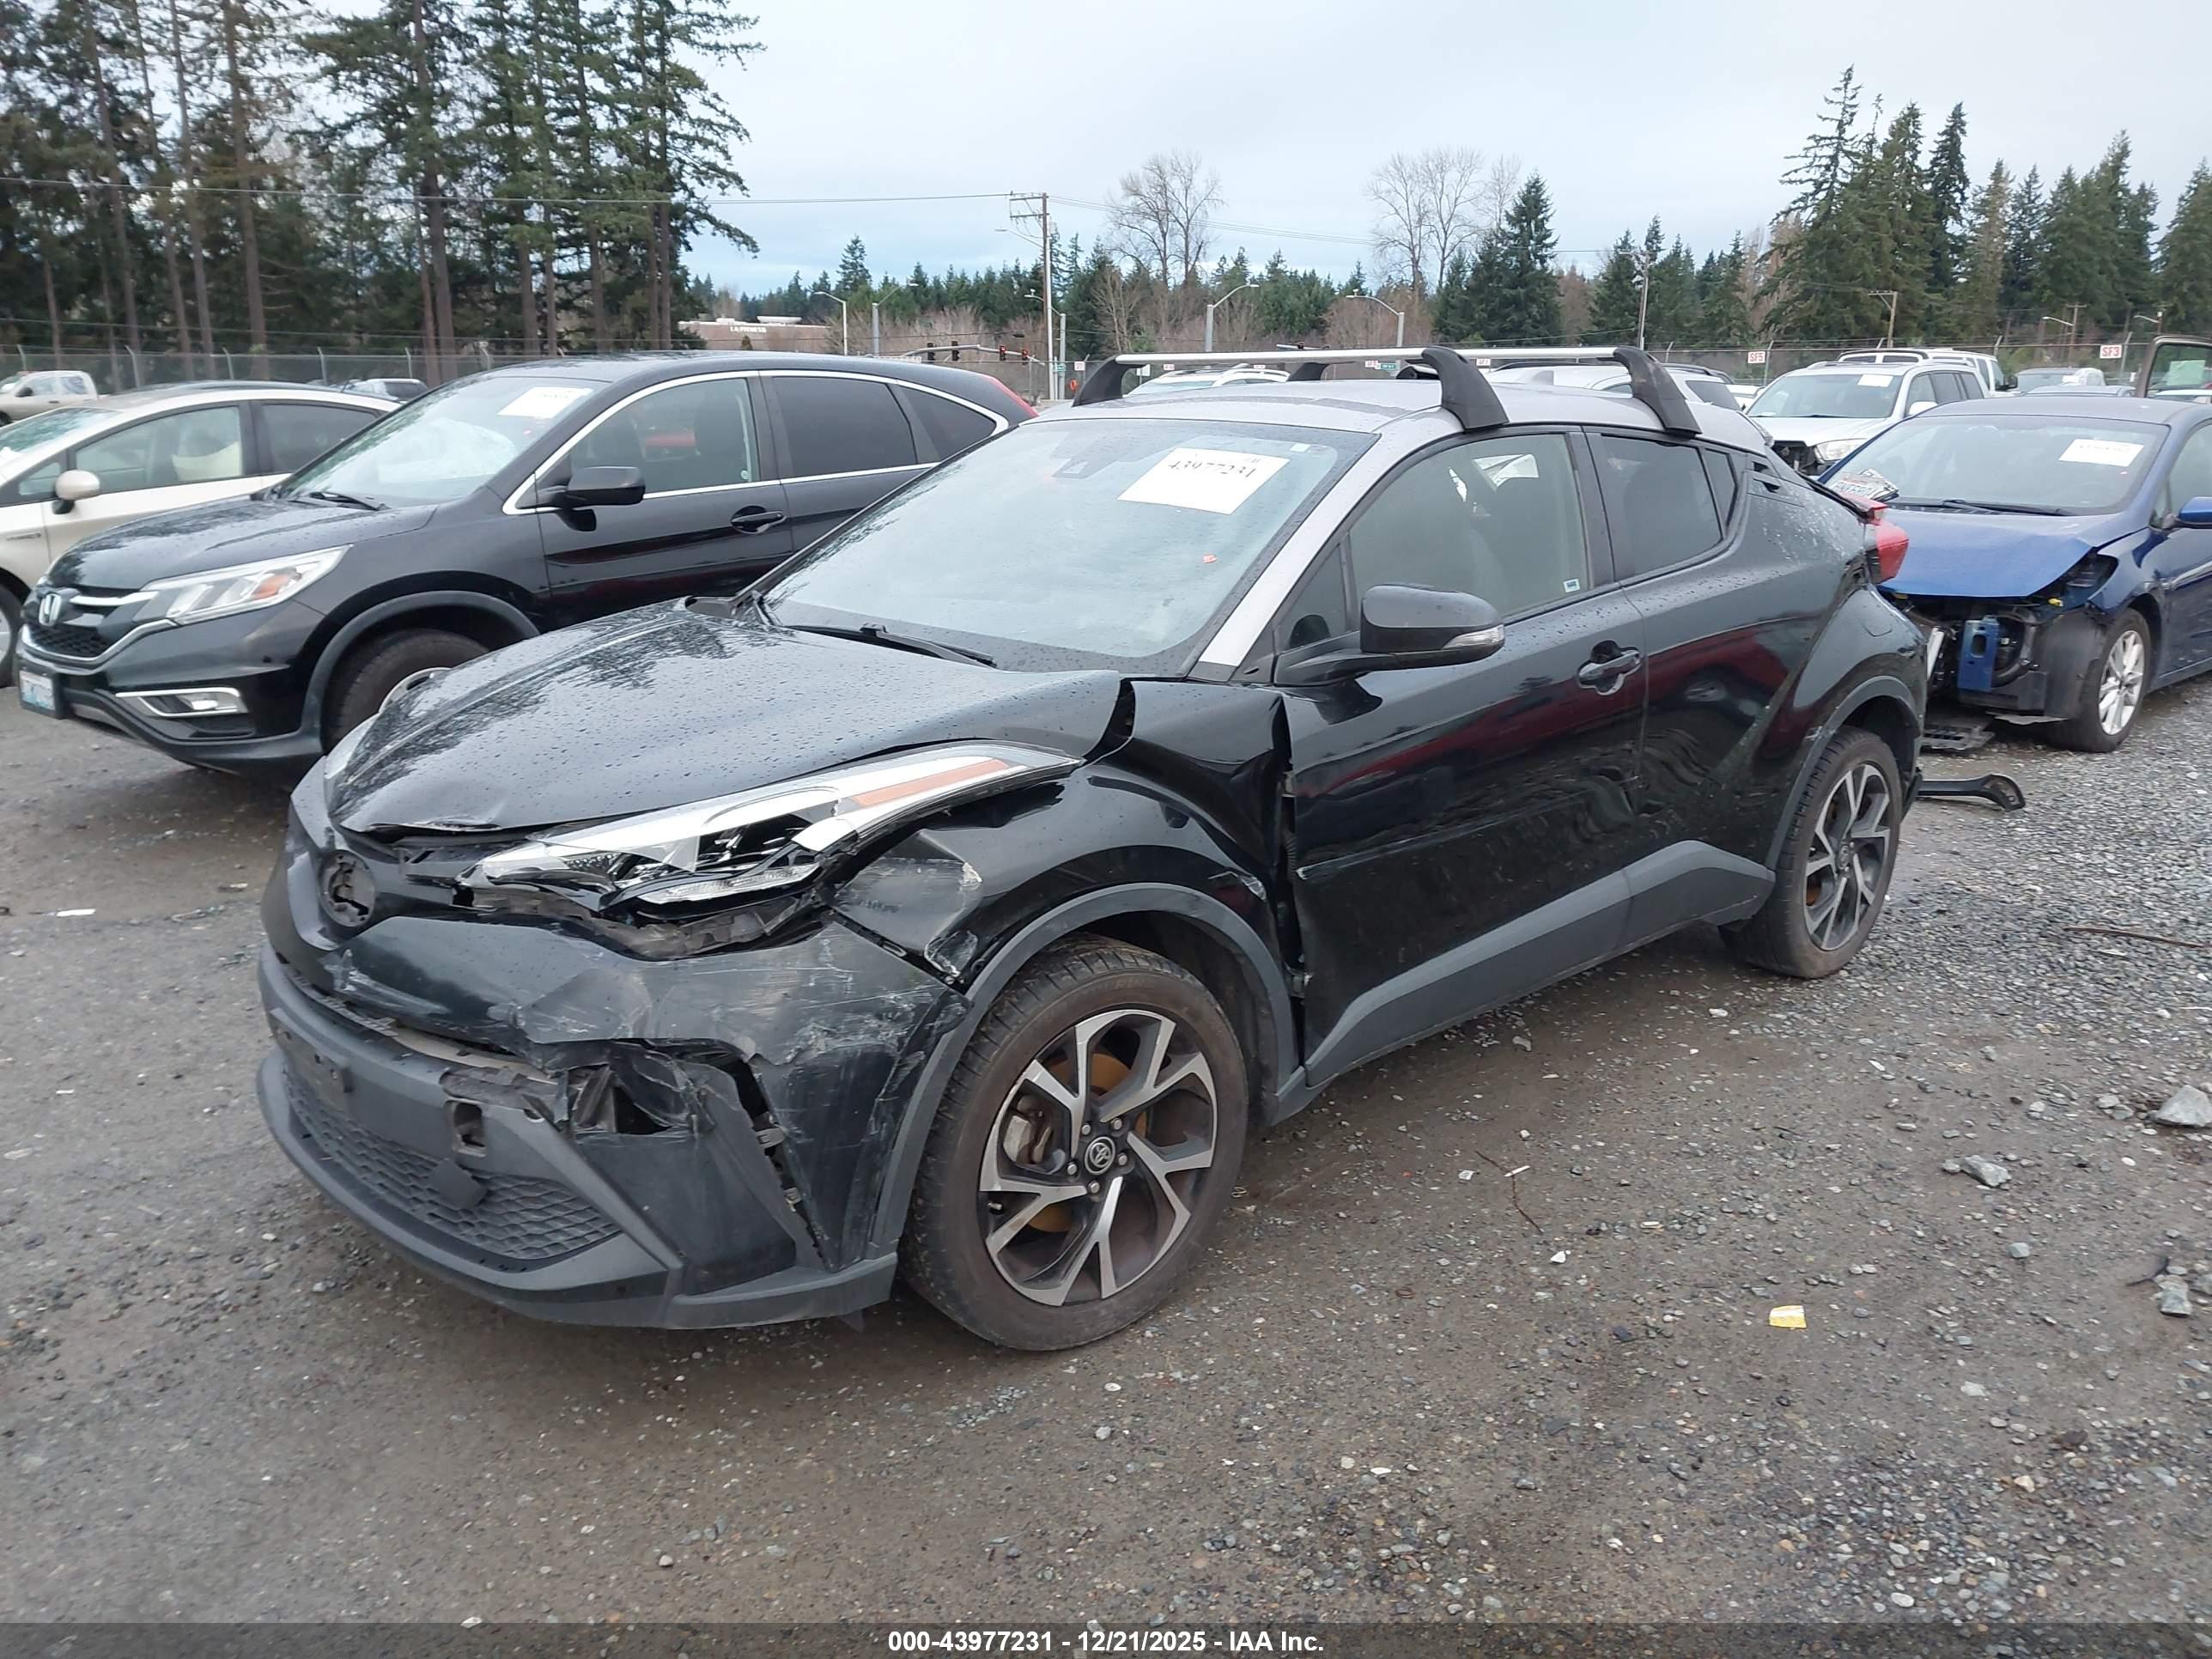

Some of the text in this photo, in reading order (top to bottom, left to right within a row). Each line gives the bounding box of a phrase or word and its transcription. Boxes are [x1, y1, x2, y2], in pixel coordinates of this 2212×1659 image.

[1749, 352, 1765, 362] SF5
[2101, 346, 2120, 357] SF3
[1168, 459, 1257, 478] 43977231
